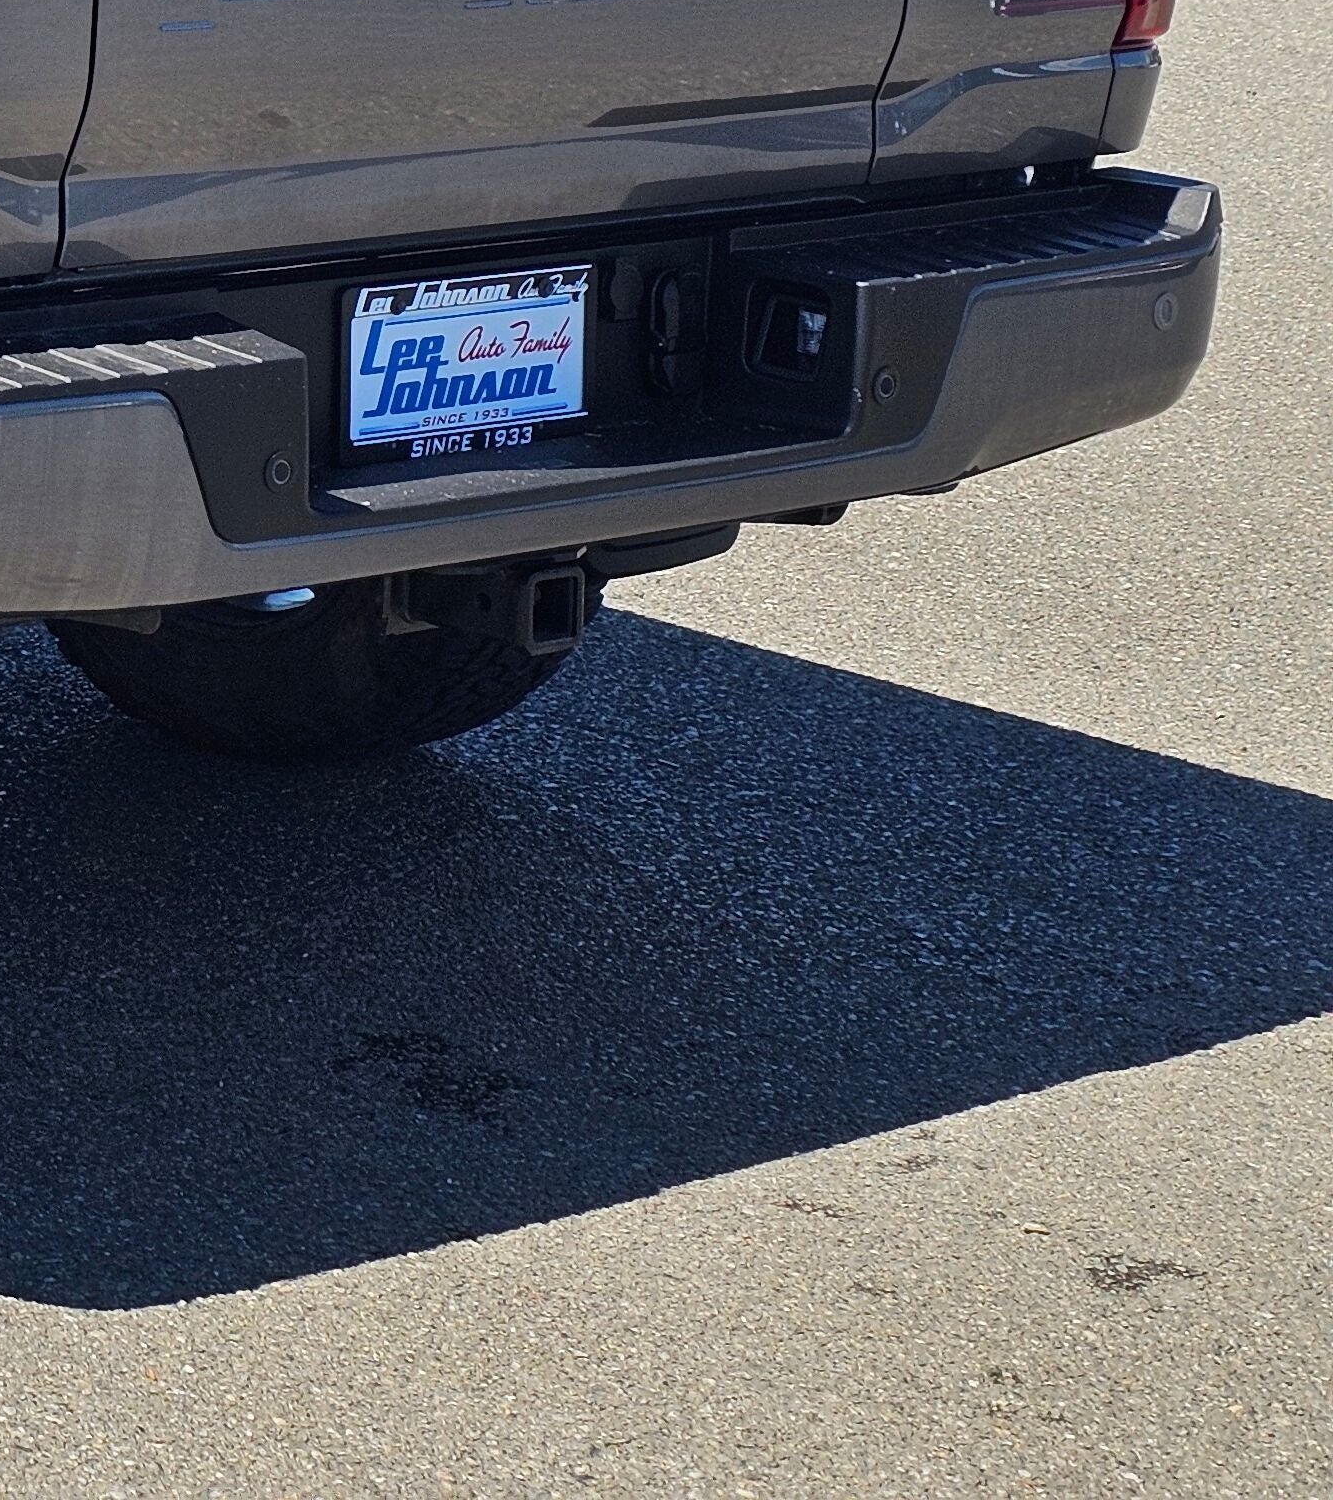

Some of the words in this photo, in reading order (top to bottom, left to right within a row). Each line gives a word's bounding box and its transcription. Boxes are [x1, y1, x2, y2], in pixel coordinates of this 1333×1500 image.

[405, 280, 511, 310] Johnson
[360, 319, 449, 376] Lee
[458, 326, 506, 363] Auto
[509, 317, 573, 364] Family
[363, 357, 558, 419] Johnson
[421, 411, 467, 428] SINCE
[469, 407, 510, 424] 1933
[410, 434, 473, 459] SINCE
[484, 426, 533, 449] 1933
